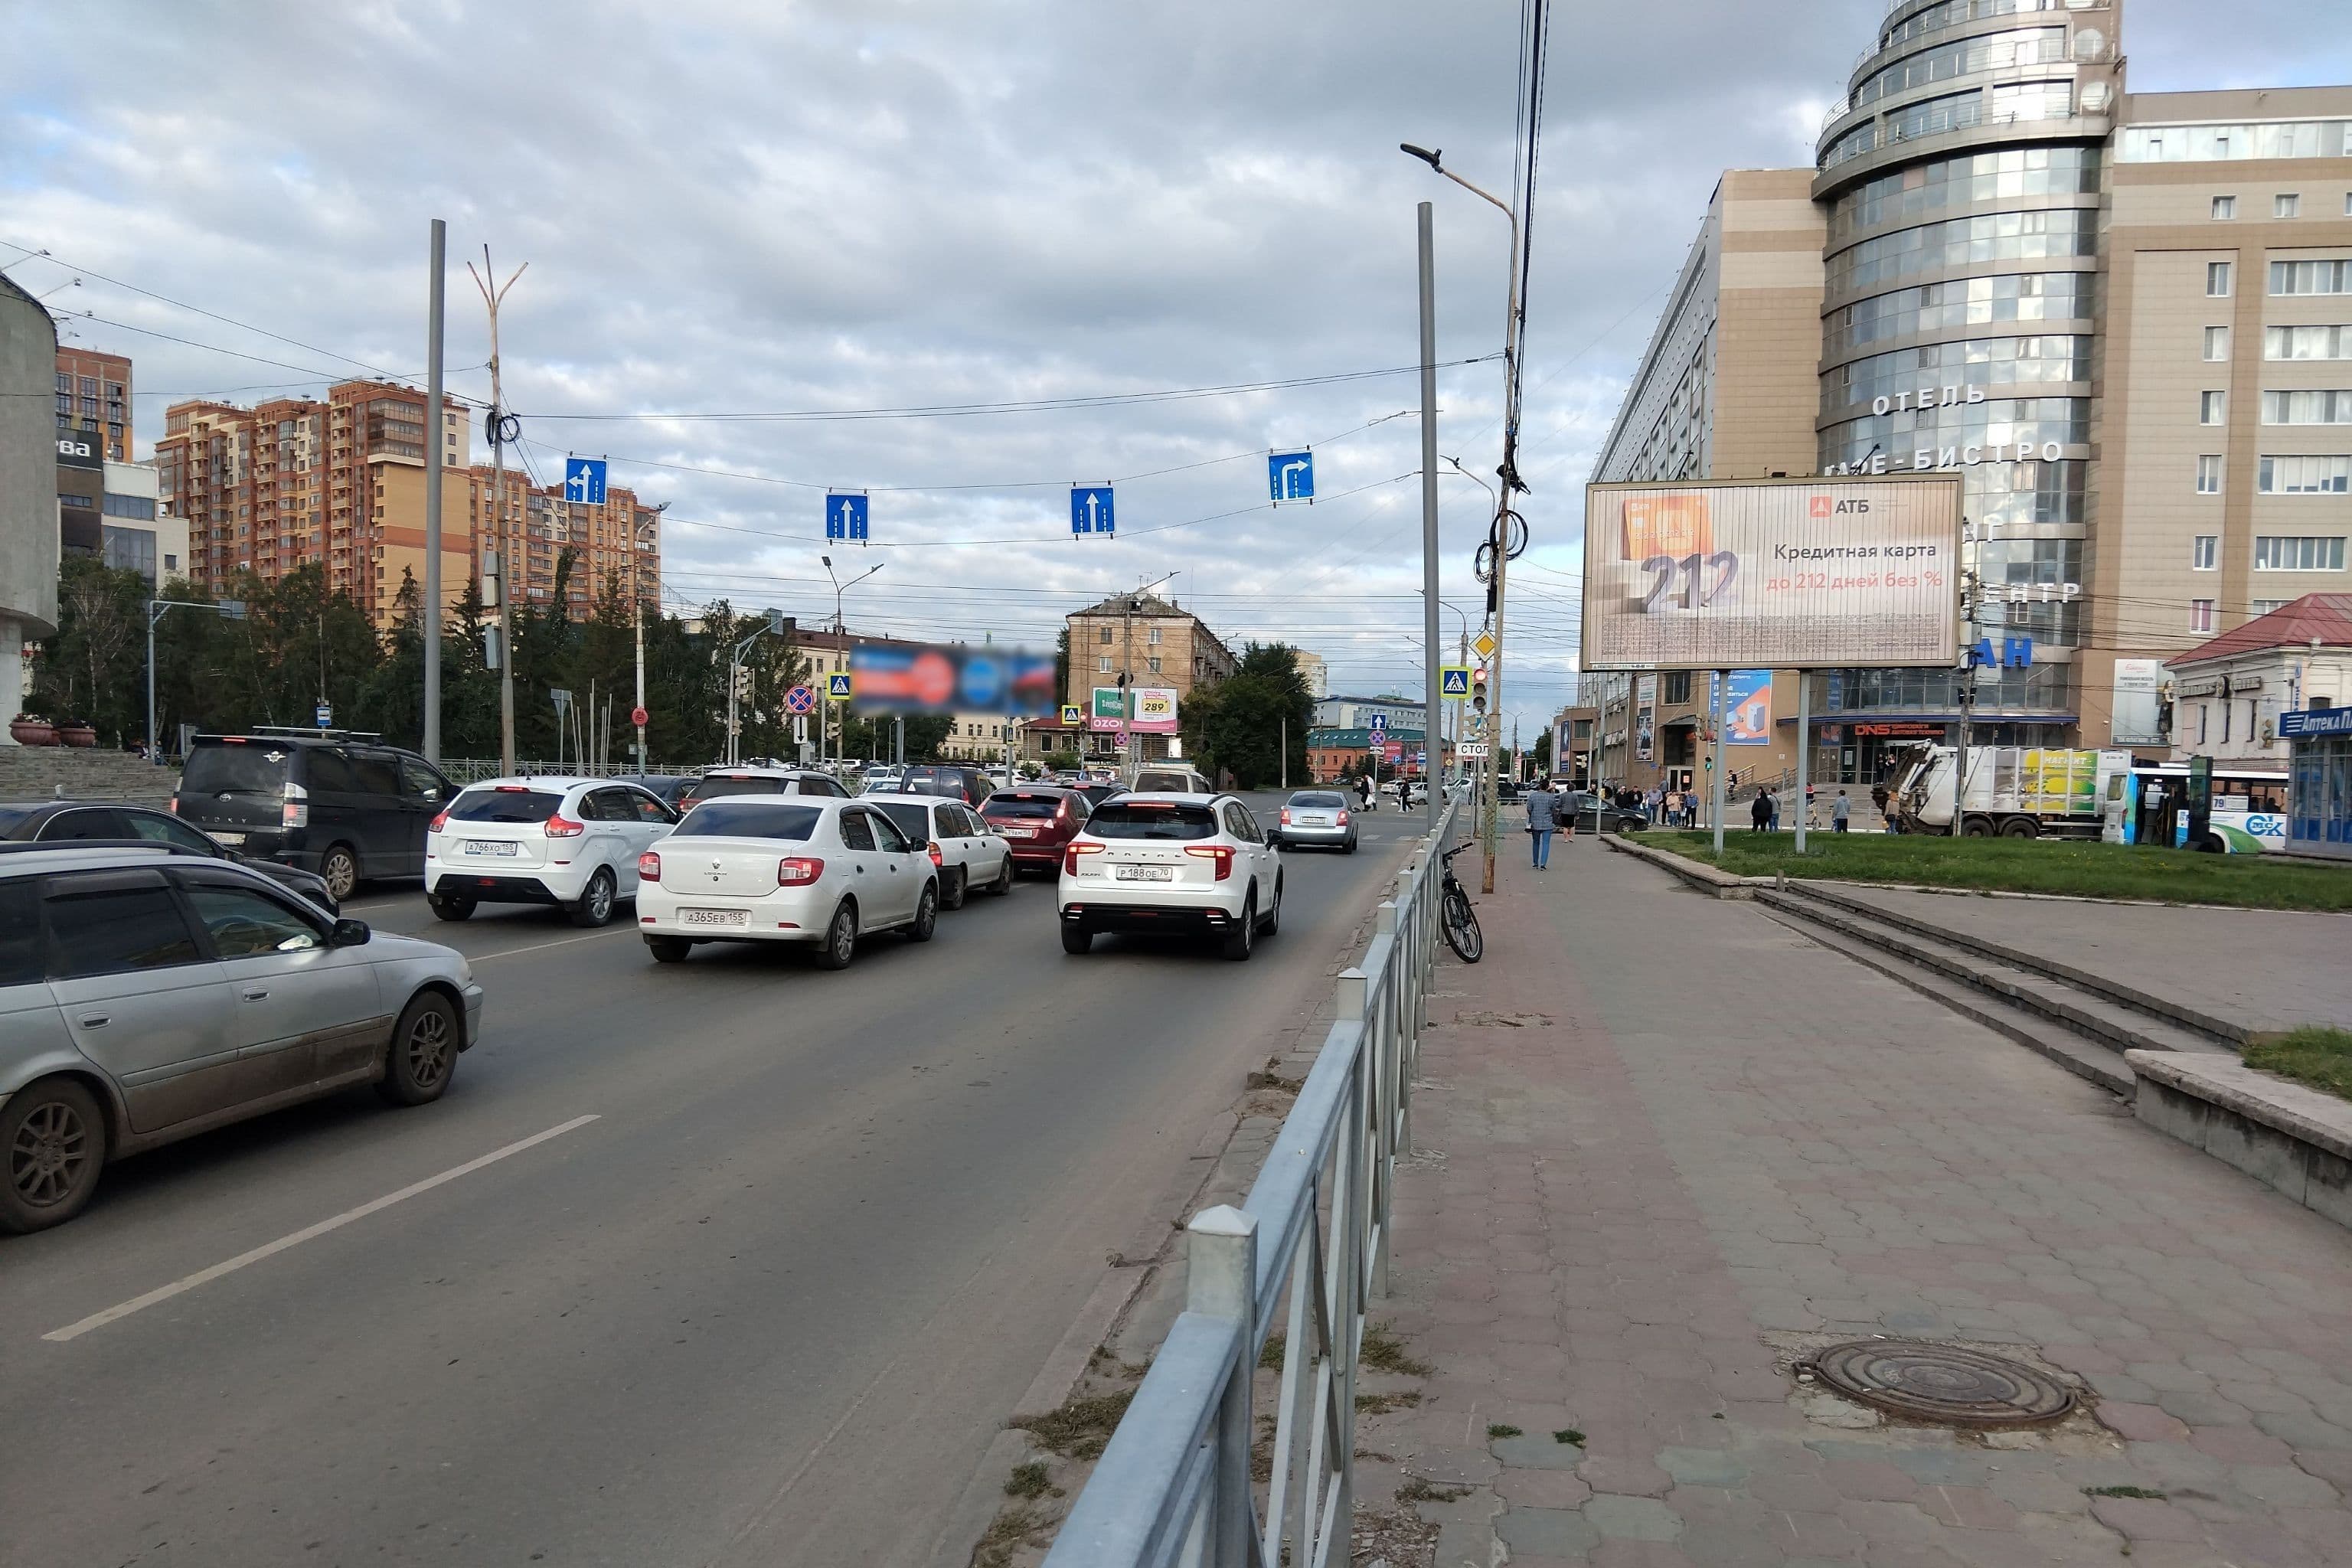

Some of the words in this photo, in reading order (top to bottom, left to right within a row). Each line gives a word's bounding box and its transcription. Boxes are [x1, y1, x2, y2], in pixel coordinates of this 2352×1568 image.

[1873, 384, 1984, 416] ОТЕЛЬ
[1835, 499, 1870, 514] АТБ
[1774, 544, 1877, 564] Кредитная
[1884, 545, 1936, 560] карта
[1640, 551, 1739, 613] 212
[1766, 579, 1790, 591] до
[1795, 573, 1826, 589] 212
[1831, 573, 1879, 590] дней
[1884, 572, 1918, 587] без
[1984, 583, 2079, 603] ЕНТР
[1855, 724, 1890, 735] DNS
[2213, 799, 2225, 808] 79
[688, 912, 725, 923] А365ЕВ
[728, 913, 743, 921] 155
